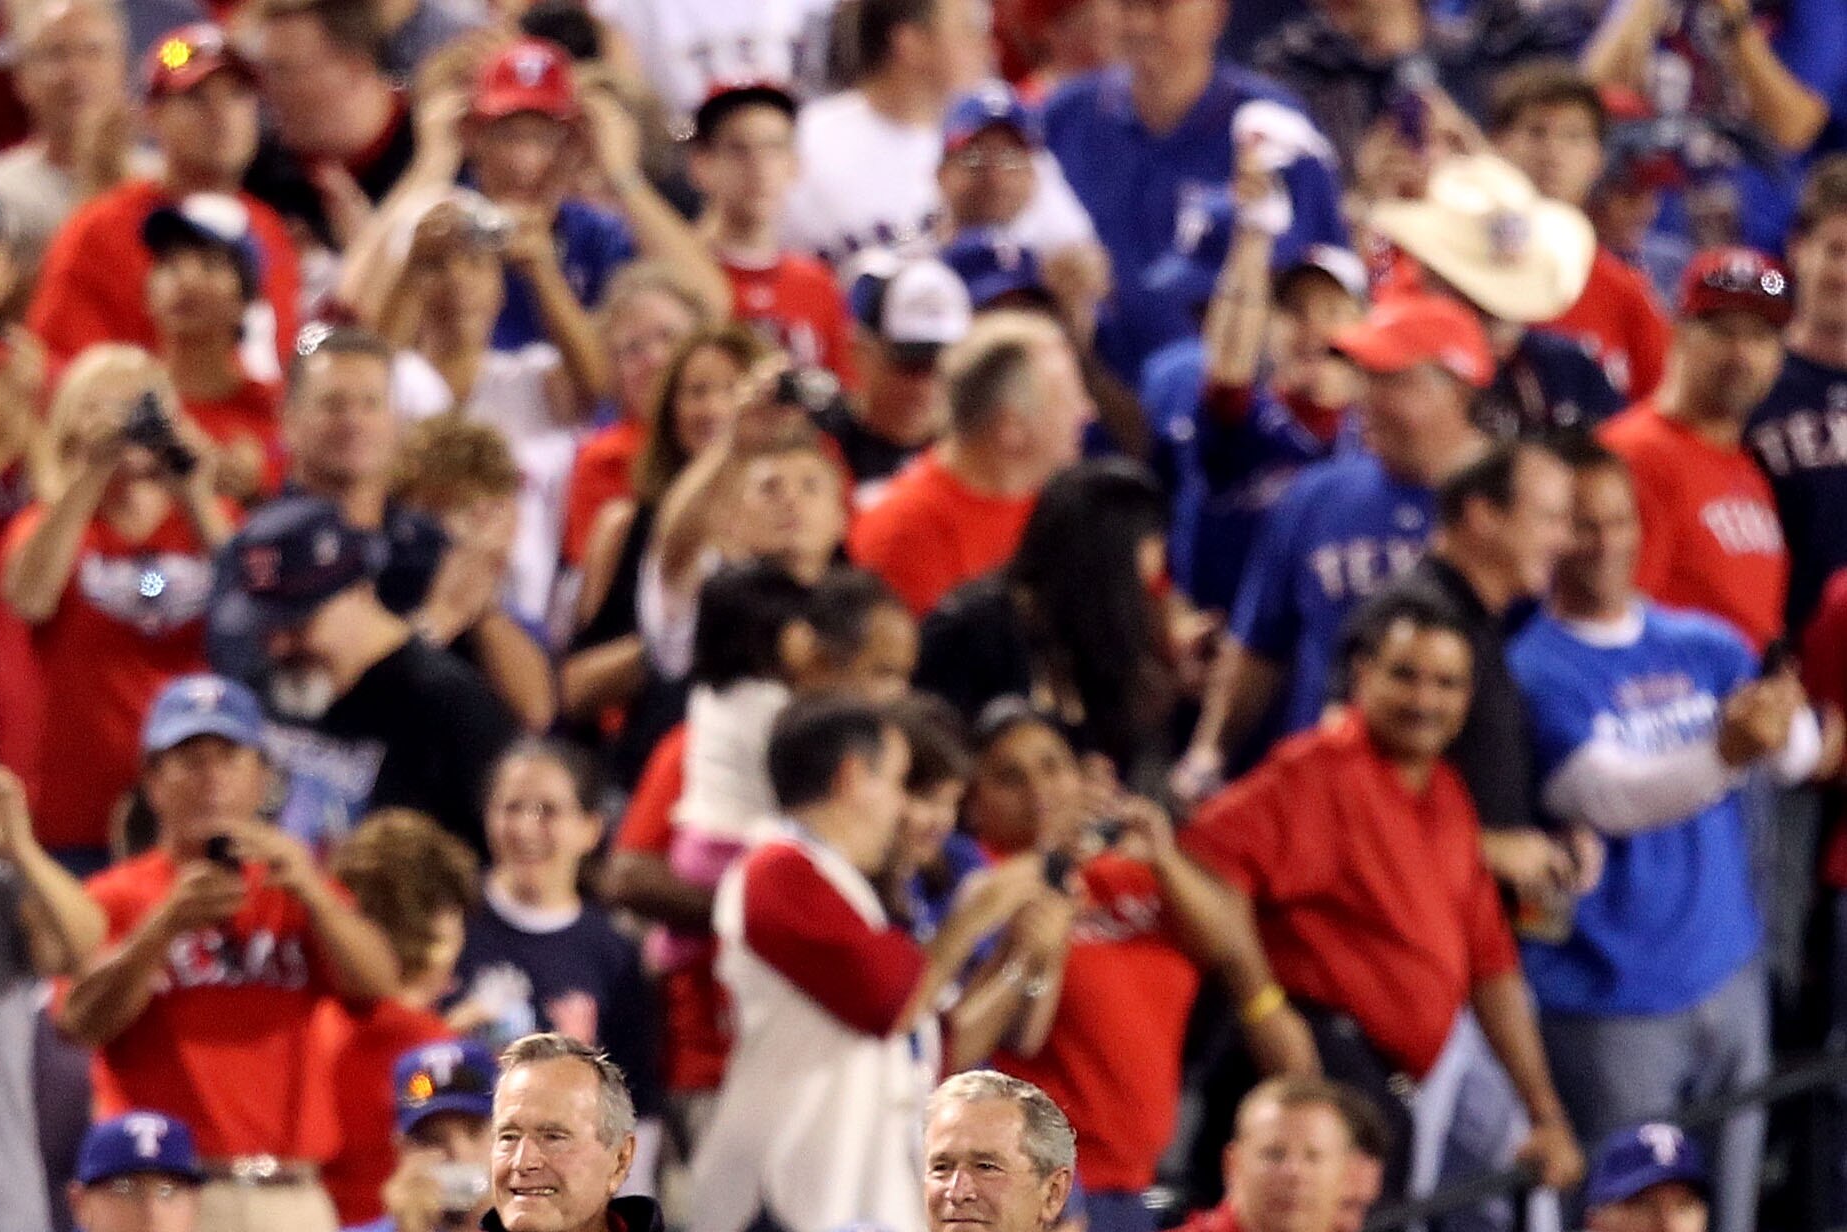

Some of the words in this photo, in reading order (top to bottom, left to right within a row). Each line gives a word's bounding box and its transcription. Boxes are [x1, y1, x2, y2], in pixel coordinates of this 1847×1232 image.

[421, 1040, 465, 1086] T
[123, 1112, 169, 1158] T
[1637, 1122, 1683, 1166] T
